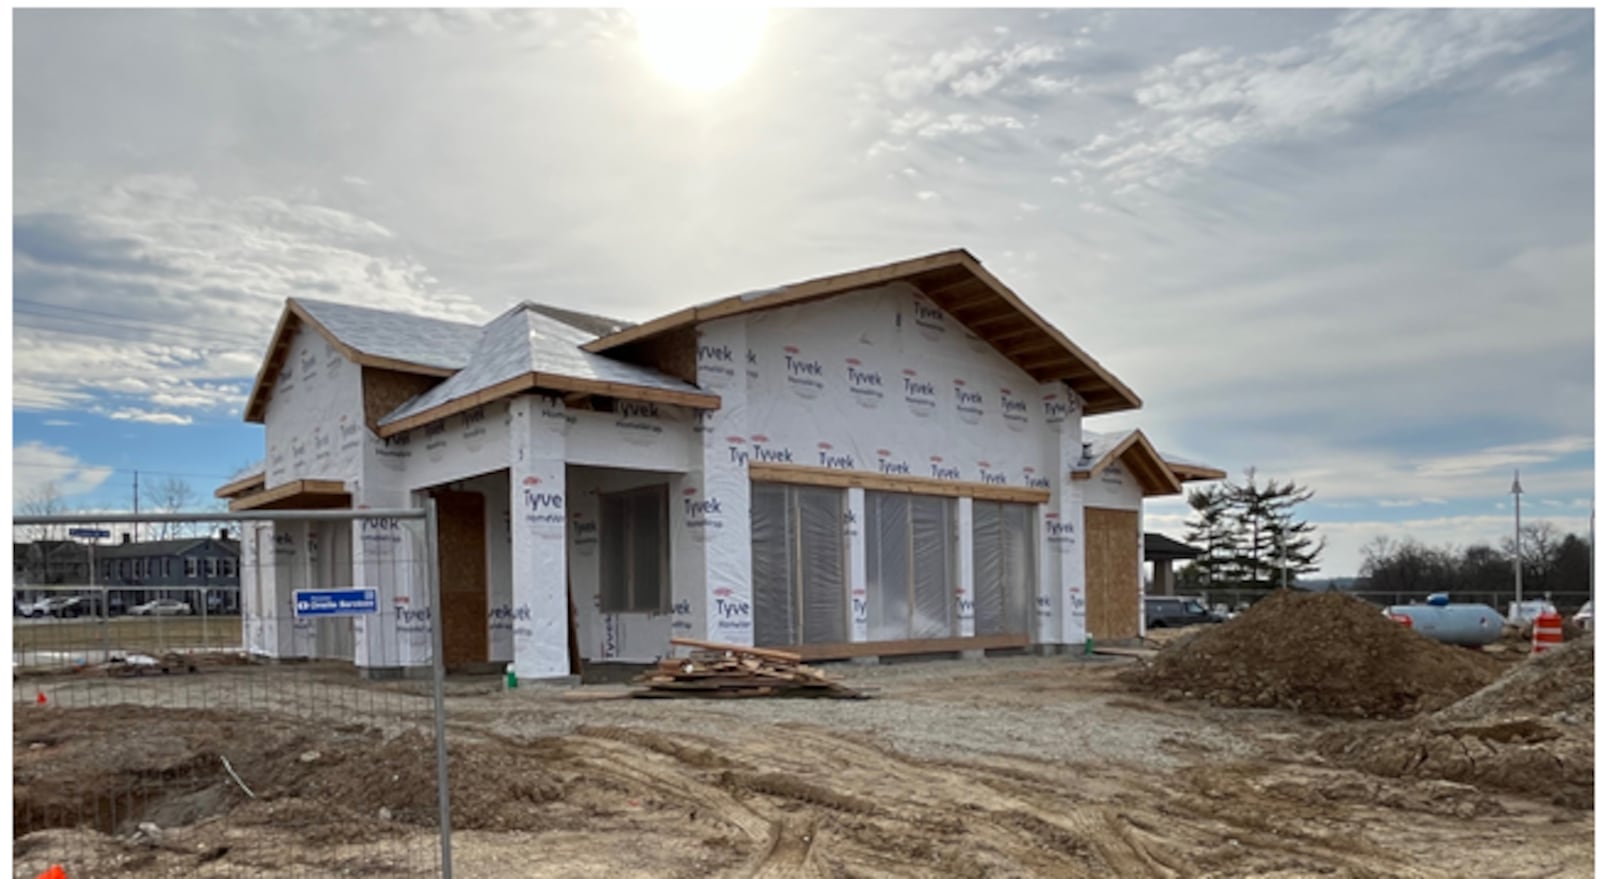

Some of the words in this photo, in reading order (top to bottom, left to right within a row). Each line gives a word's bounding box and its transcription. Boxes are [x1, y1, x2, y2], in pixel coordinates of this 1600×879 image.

[698, 346, 733, 362] yvek
[784, 355, 823, 377] Tyvek
[848, 366, 883, 386] Tyvek
[904, 377, 935, 396] Tyvek
[954, 387, 983, 404] Tyvek
[753, 444, 793, 463] Tyvek
[819, 452, 855, 469] Tyvek
[878, 459, 910, 475] Tyvek
[931, 464, 960, 480] Tyvek
[979, 469, 1008, 485] Tyvek
[1023, 474, 1050, 489] Tyvek
[684, 497, 722, 518] Tyvek
[715, 599, 750, 619] Tyve
